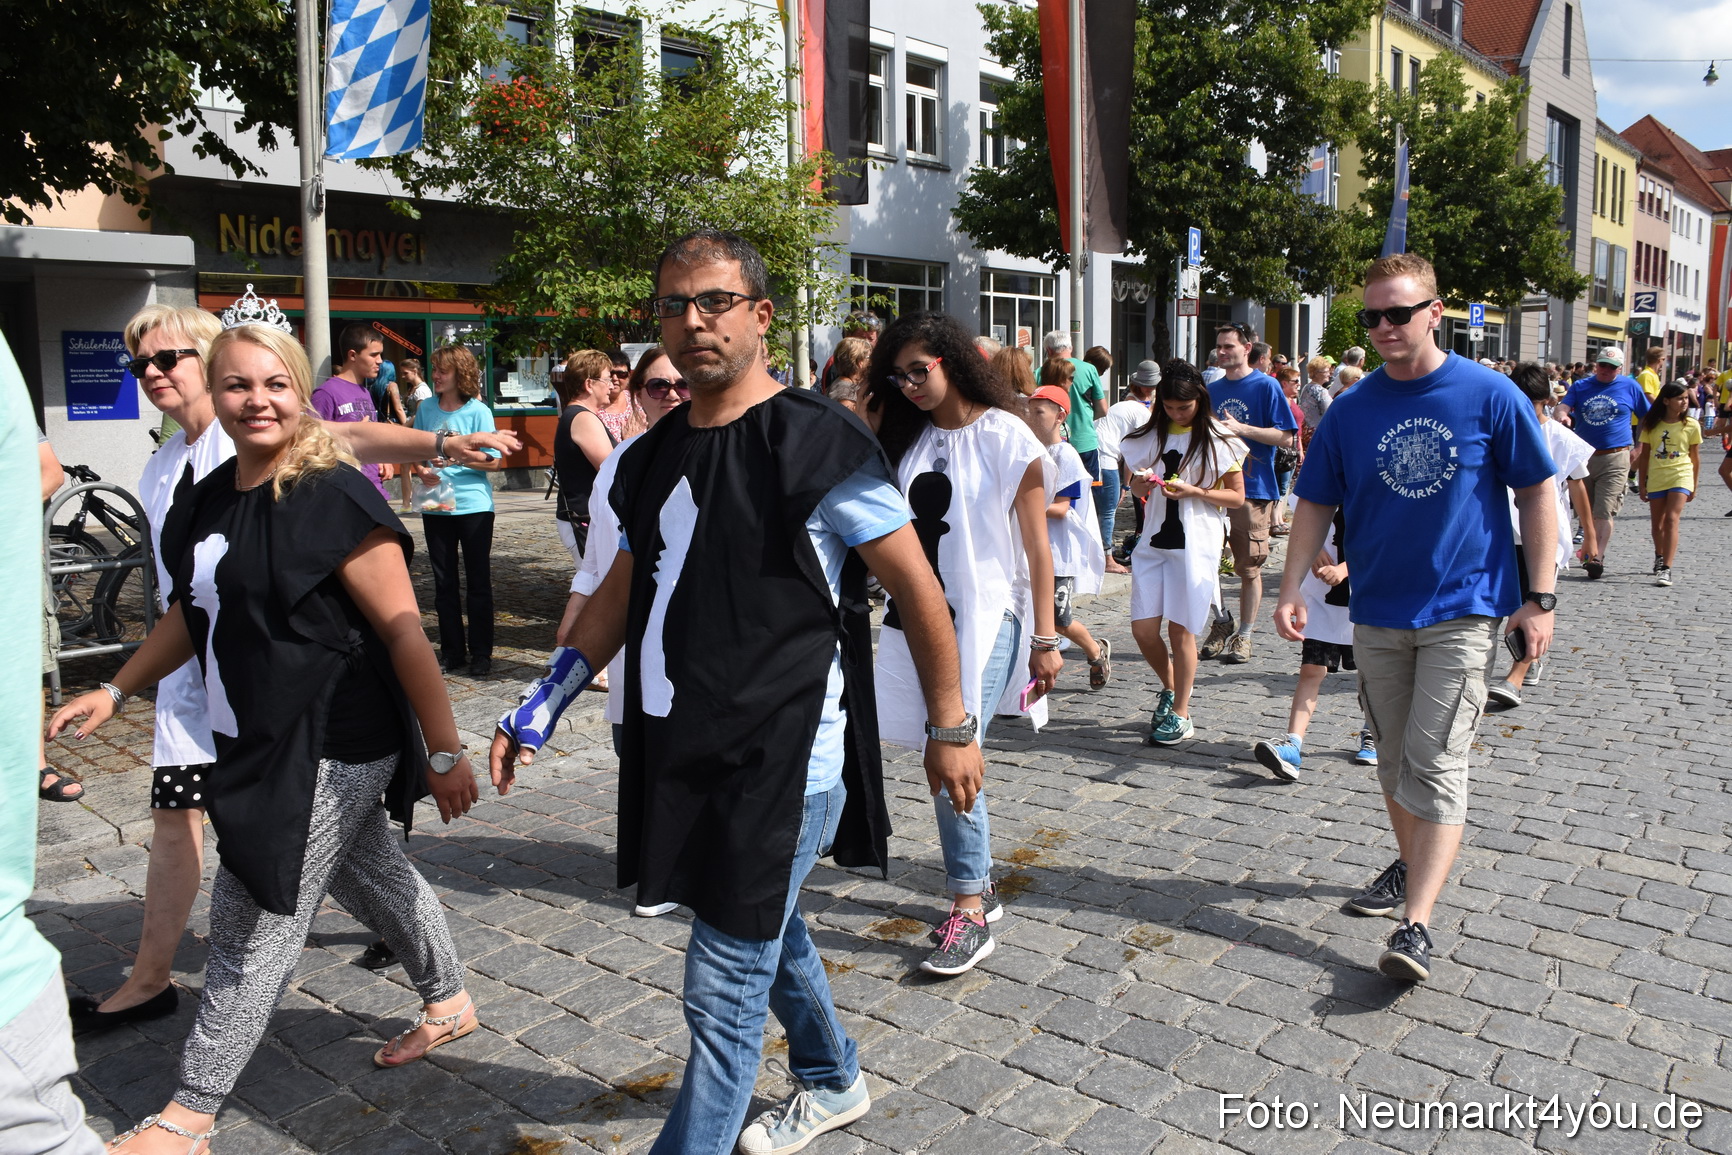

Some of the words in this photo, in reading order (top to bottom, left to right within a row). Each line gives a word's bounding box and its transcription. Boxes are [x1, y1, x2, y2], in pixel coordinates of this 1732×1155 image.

[219, 213, 425, 272] Nidemayer
[1191, 232, 1198, 261] P
[1472, 306, 1481, 324] P
[69, 338, 124, 352] Schülerhilfe
[1216, 398, 1249, 414] SCHACHKLUB
[1583, 394, 1618, 406] SCHACHKLUB
[1377, 417, 1454, 452] SCHACHKLUB
[1379, 470, 1443, 499] NEUMARKT
[1442, 462, 1458, 481] E.V.
